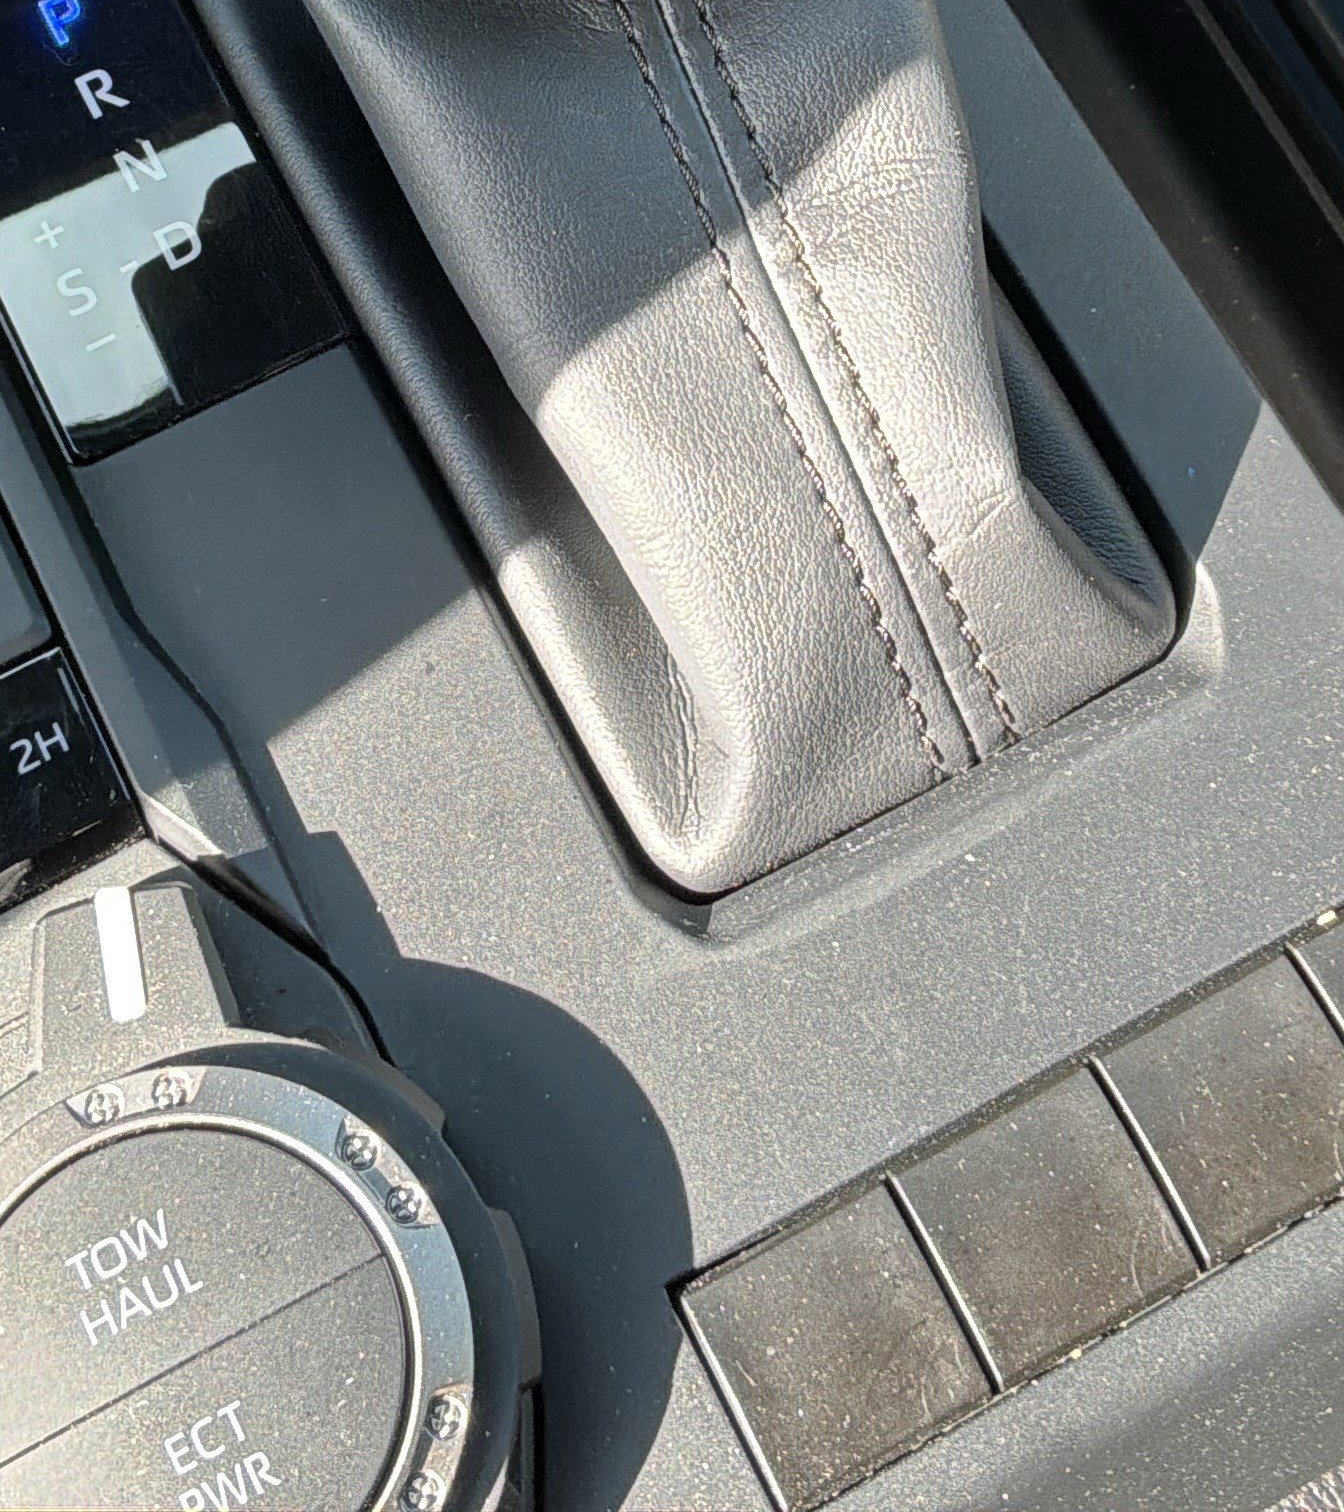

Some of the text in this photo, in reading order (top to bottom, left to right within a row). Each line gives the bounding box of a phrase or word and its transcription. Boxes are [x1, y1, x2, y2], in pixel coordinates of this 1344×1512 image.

[74, 68, 130, 120] R
[112, 138, 169, 193] N
[153, 219, 203, 271] D
[56, 267, 99, 317] S
[10, 722, 71, 775] 2H
[65, 1208, 171, 1290] TOW
[79, 1255, 204, 1346] HAUL
[162, 1399, 248, 1476] ECT
[179, 1450, 281, 1511] PWR
